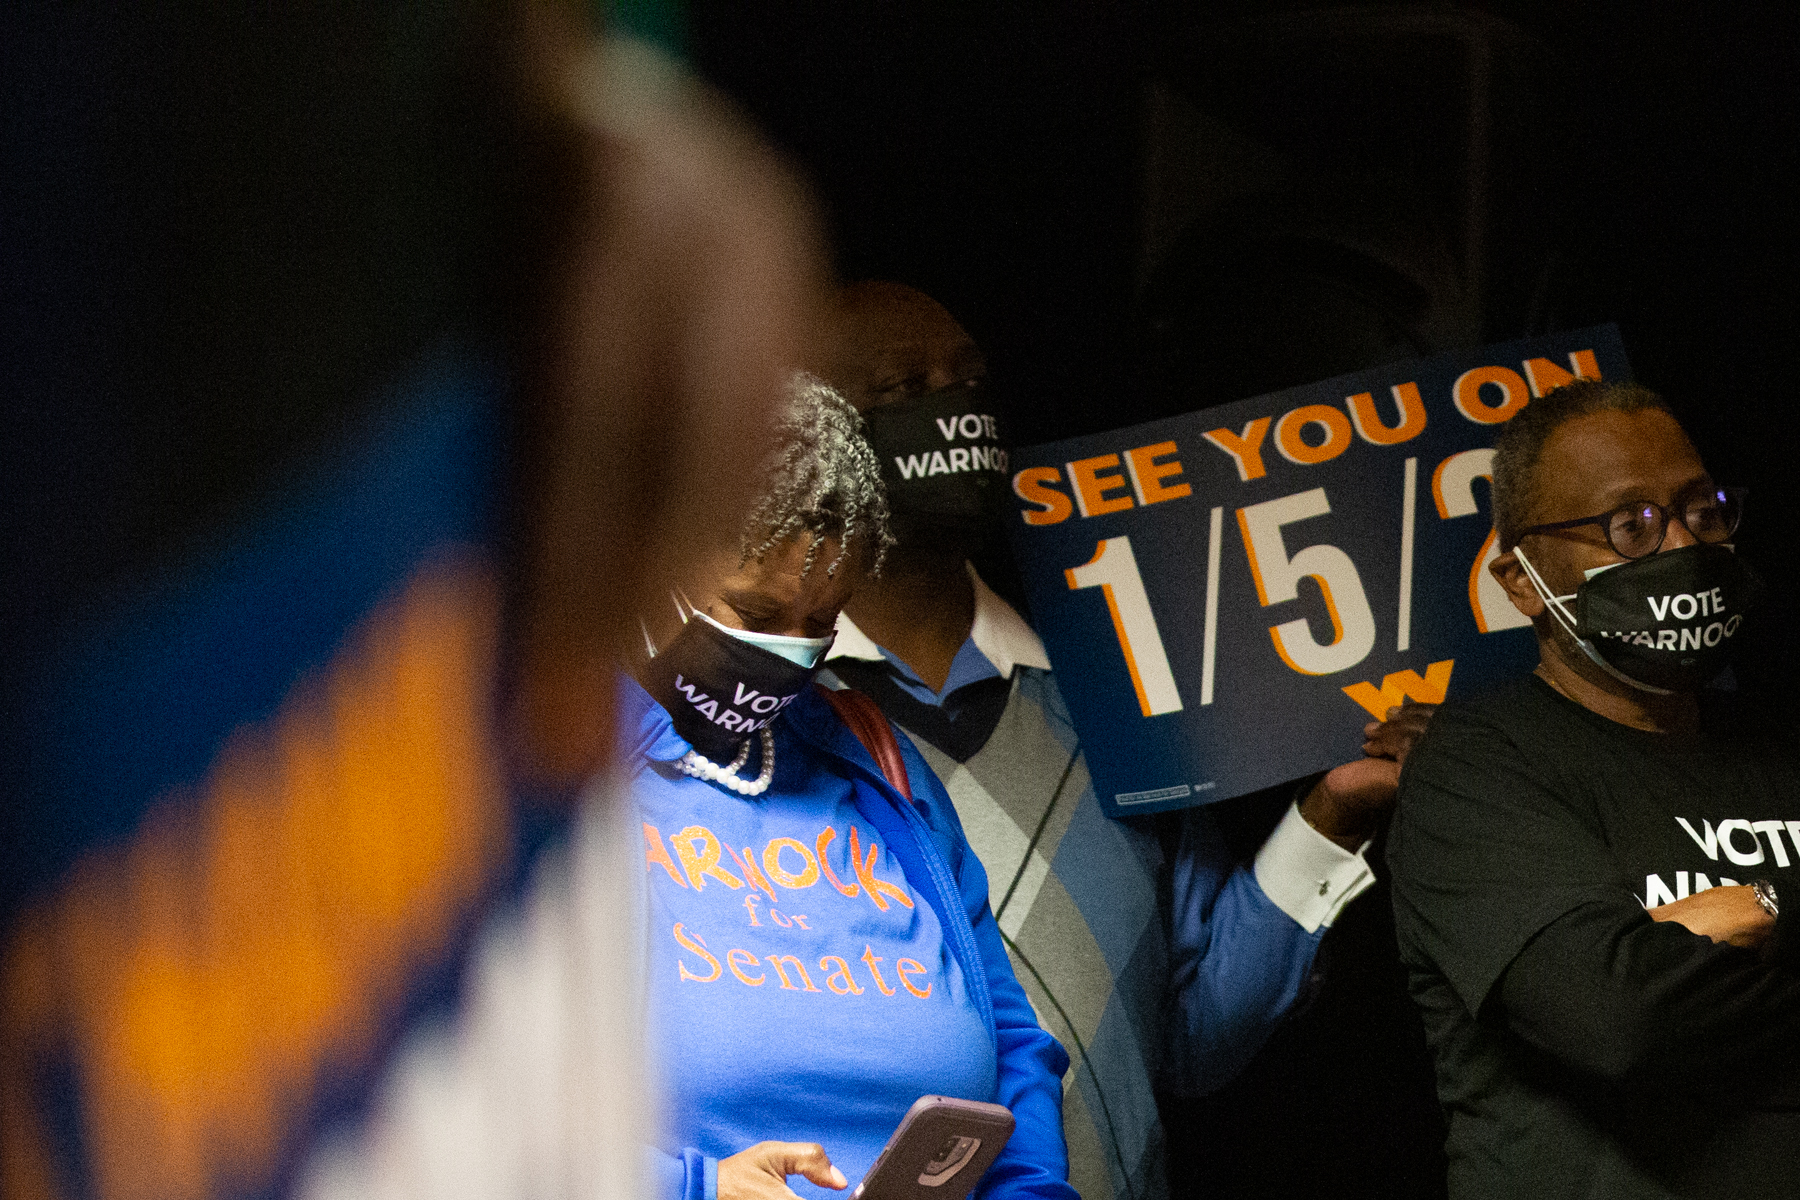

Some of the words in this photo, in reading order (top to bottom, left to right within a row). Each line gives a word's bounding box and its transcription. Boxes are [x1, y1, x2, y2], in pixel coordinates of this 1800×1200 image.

[1013, 440, 1193, 526] SEE
[1202, 381, 1428, 482] YOU
[1065, 447, 1535, 718] 1/5/2
[1647, 587, 1726, 621] VOTE
[733, 682, 798, 713] VOT
[642, 822, 915, 912] ARNOCK
[742, 894, 812, 930] for
[673, 922, 932, 999] Senate
